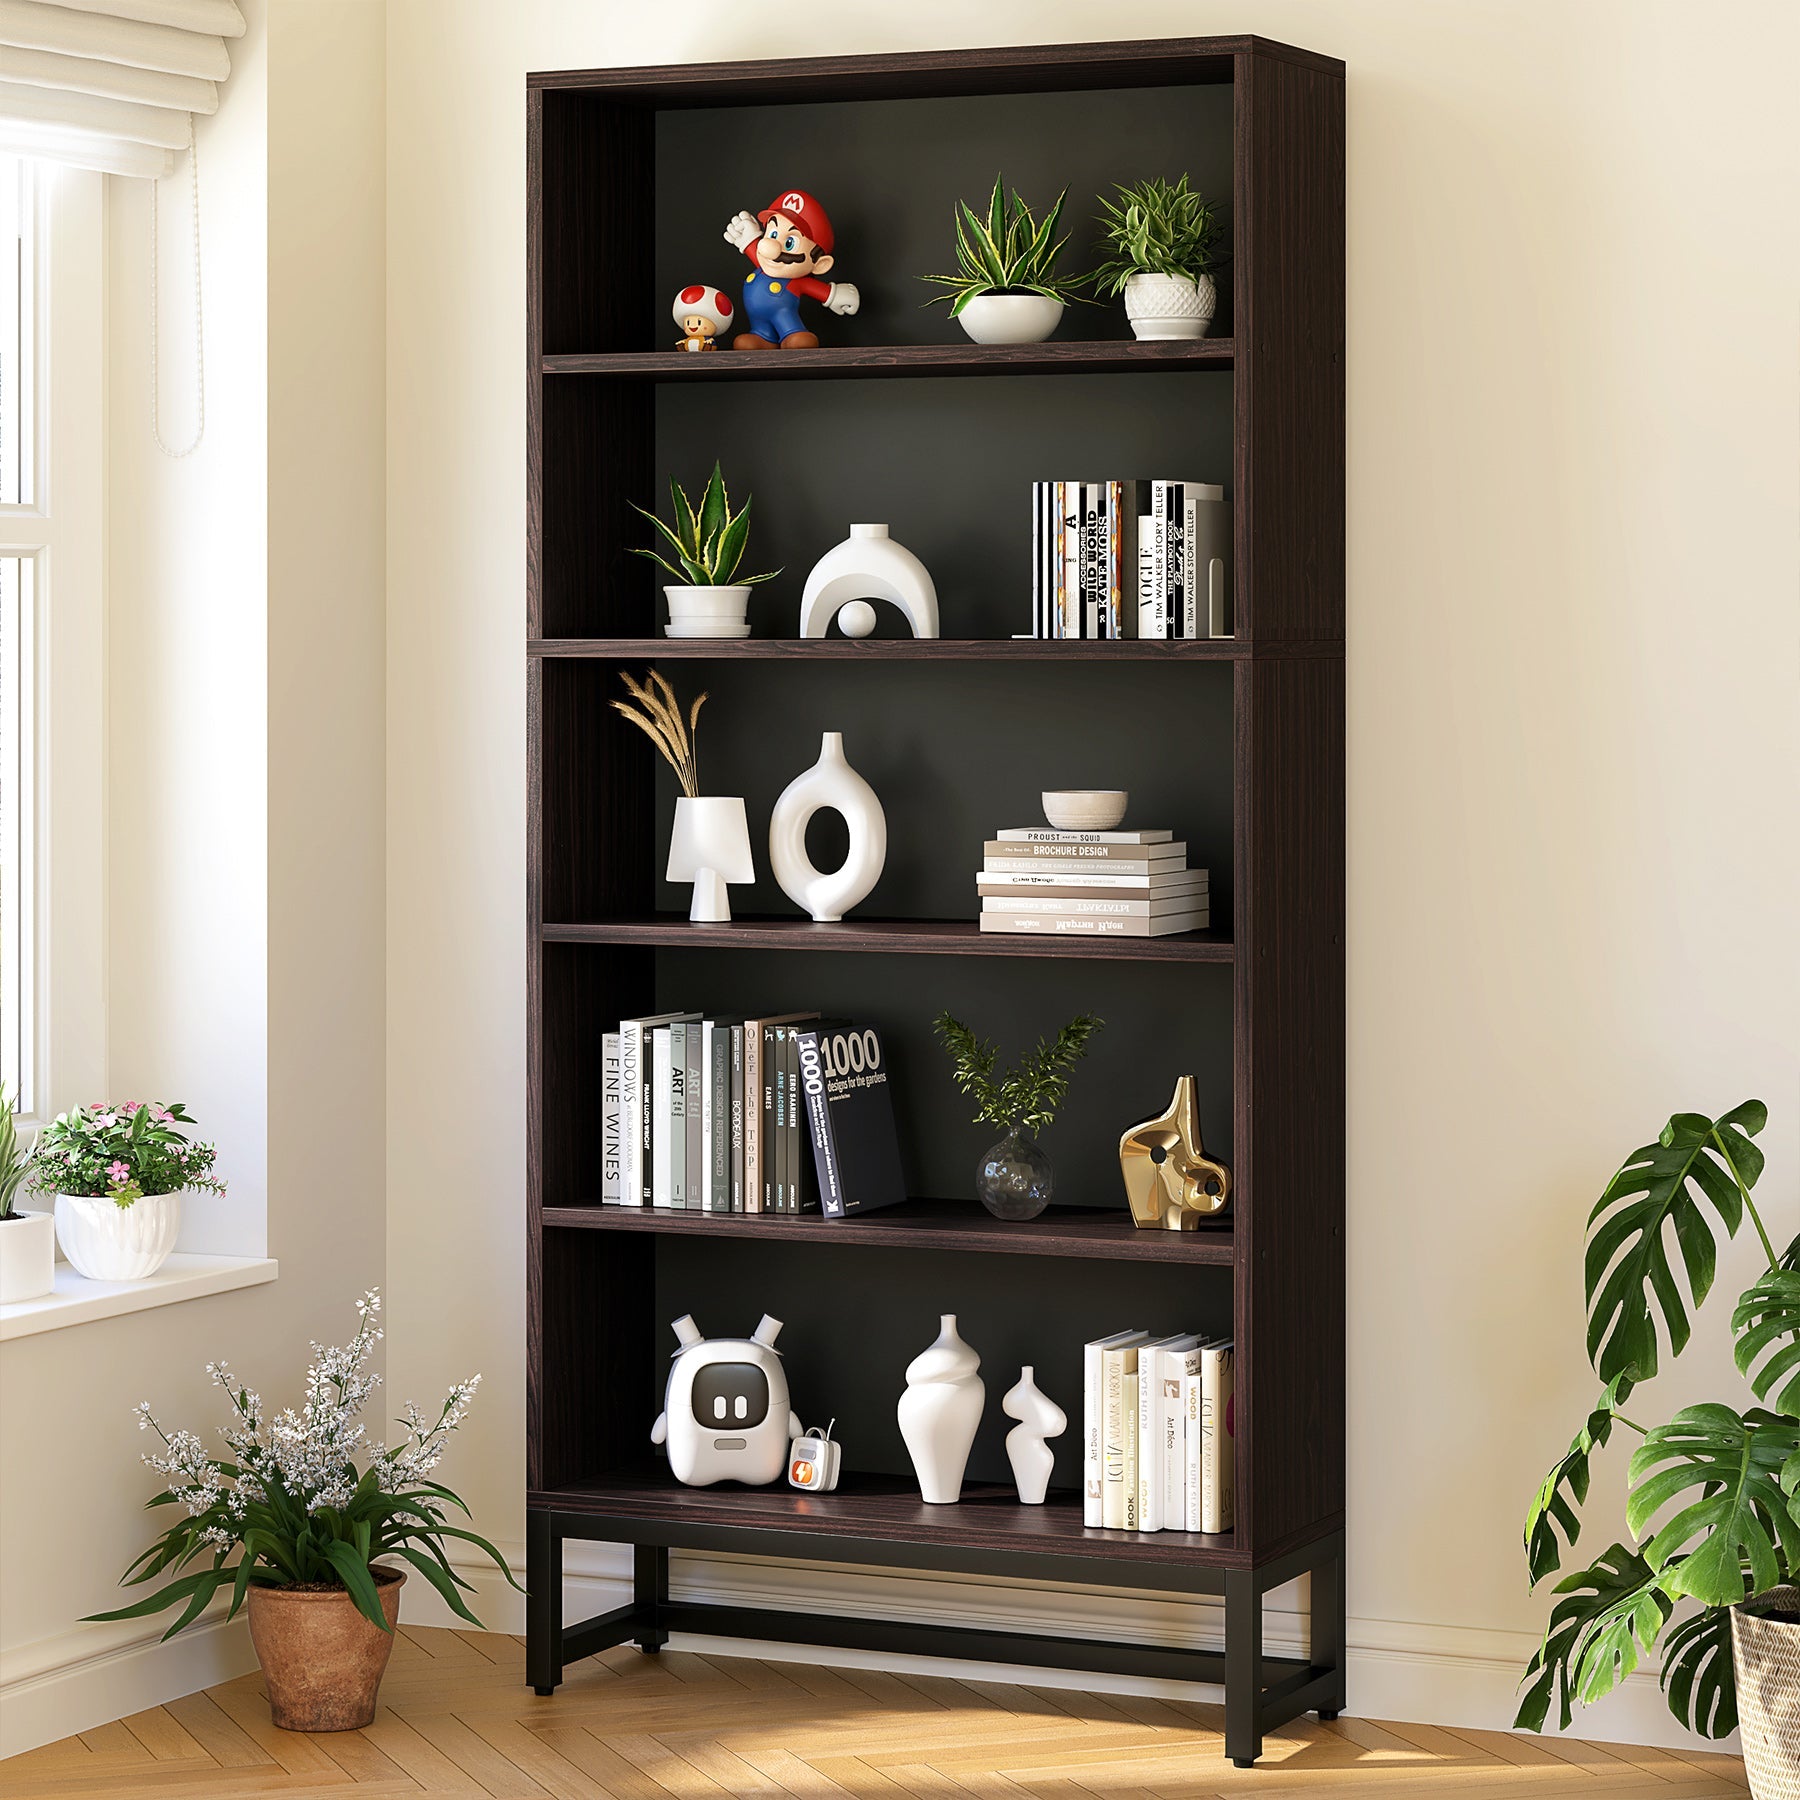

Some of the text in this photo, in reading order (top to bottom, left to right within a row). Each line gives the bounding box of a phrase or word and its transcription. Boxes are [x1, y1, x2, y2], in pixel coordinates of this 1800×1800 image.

[784, 196, 800, 210] M
[1087, 510, 1097, 602] WILD WORLD
[1098, 516, 1107, 609] KATE MOSS
[1140, 547, 1152, 607] VOGUE
[1034, 845, 1077, 855] BROCHURE
[1079, 847, 1108, 856] DESIGN
[624, 1029, 636, 1102] WINDOWS
[799, 1039, 822, 1095] 1000
[820, 1029, 880, 1078] 1000
[606, 1057, 620, 1103] FINE
[672, 1067, 684, 1096] ART
[689, 1068, 700, 1096] ART
[827, 1072, 887, 1093] designs for the gardens
[606, 1113, 620, 1181] WINES
[1167, 1430, 1175, 1449] Déco
